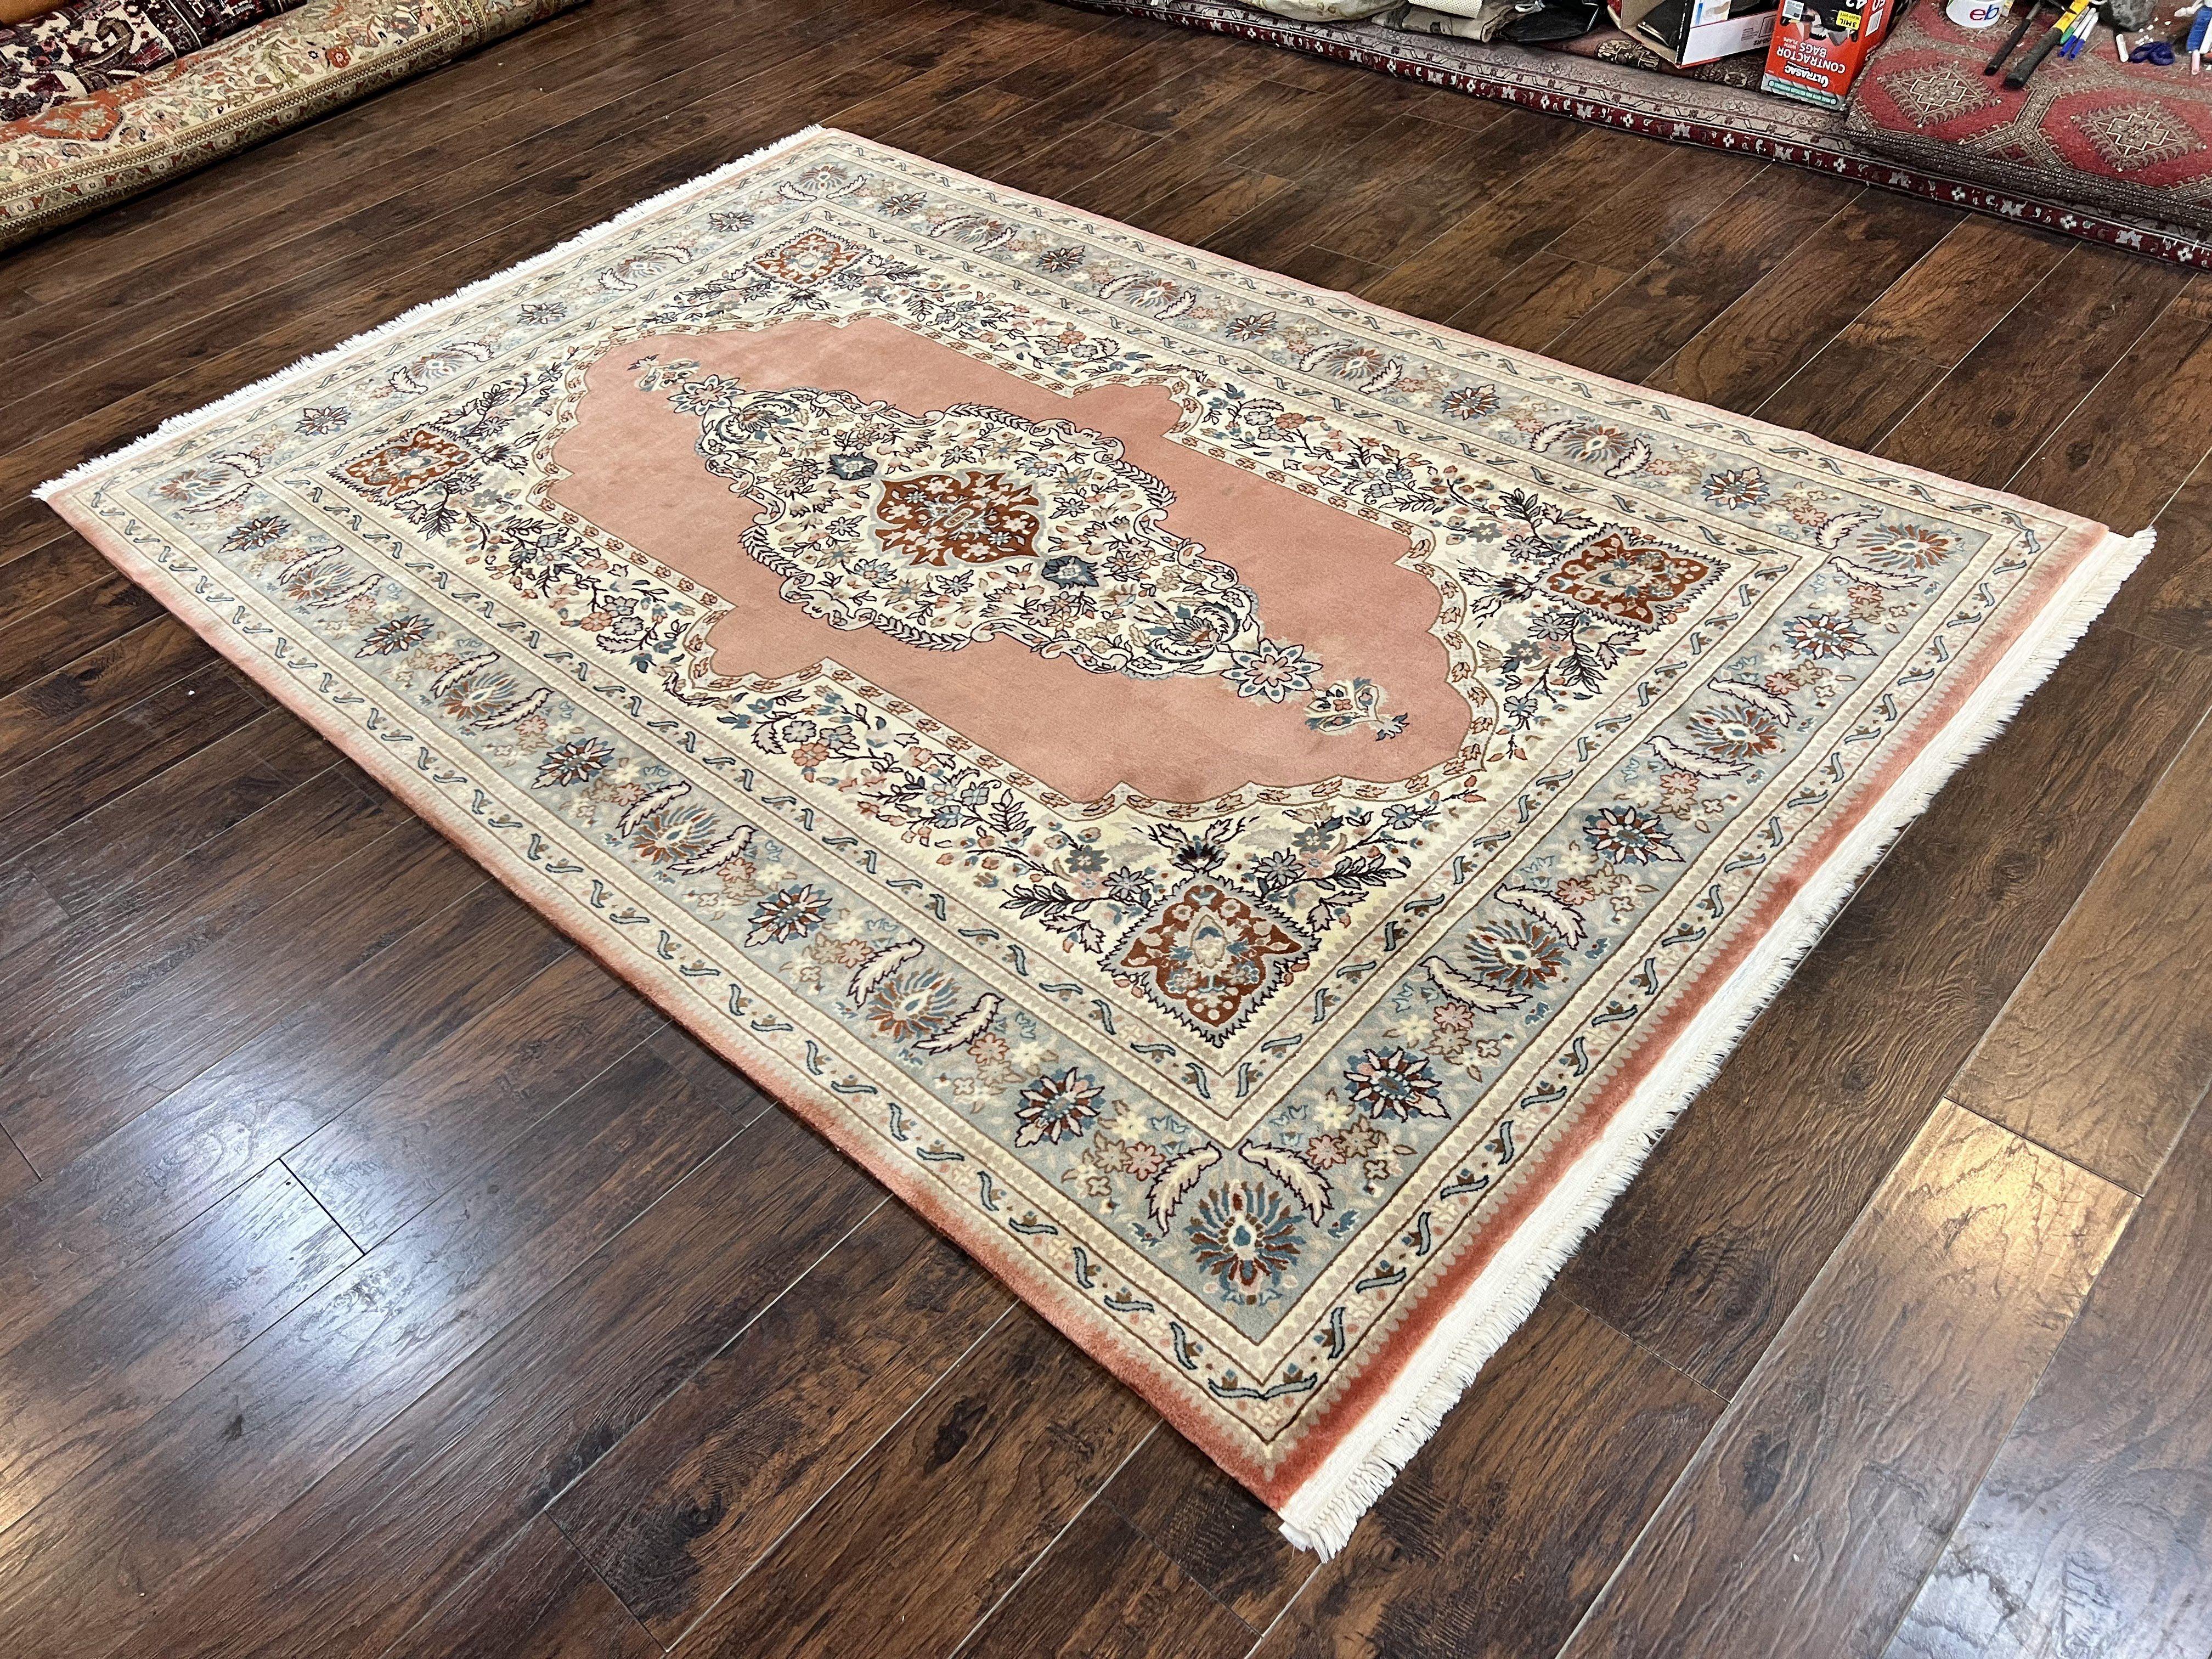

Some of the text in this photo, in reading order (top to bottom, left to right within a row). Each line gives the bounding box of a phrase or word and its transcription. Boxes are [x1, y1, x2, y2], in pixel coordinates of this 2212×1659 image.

[1839, 18, 1852, 27] MIL
[1799, 42, 1827, 58] BAGS
[1776, 46, 1846, 74] CONTRACTOR
[1784, 65, 1829, 88] ULTRASAC
